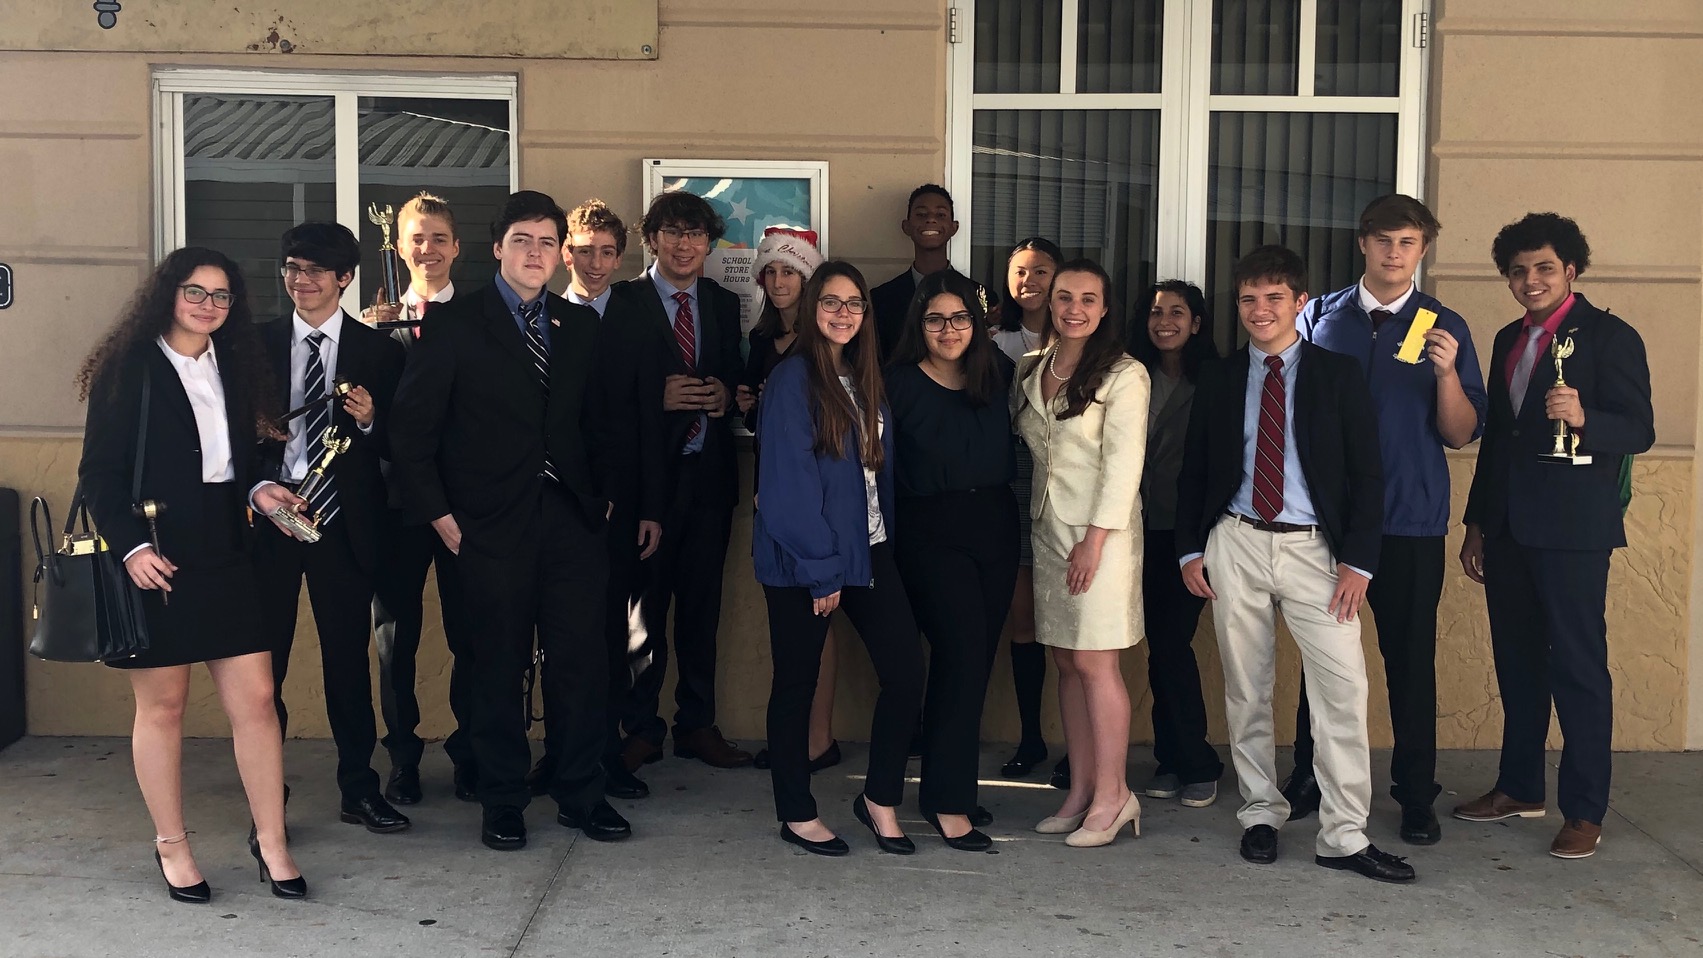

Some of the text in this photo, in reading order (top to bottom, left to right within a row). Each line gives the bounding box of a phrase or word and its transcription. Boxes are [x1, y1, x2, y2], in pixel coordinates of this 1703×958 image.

[721, 257, 752, 265] SCHOOL
[724, 266, 750, 274] STORE
[723, 275, 751, 283] HOURS
